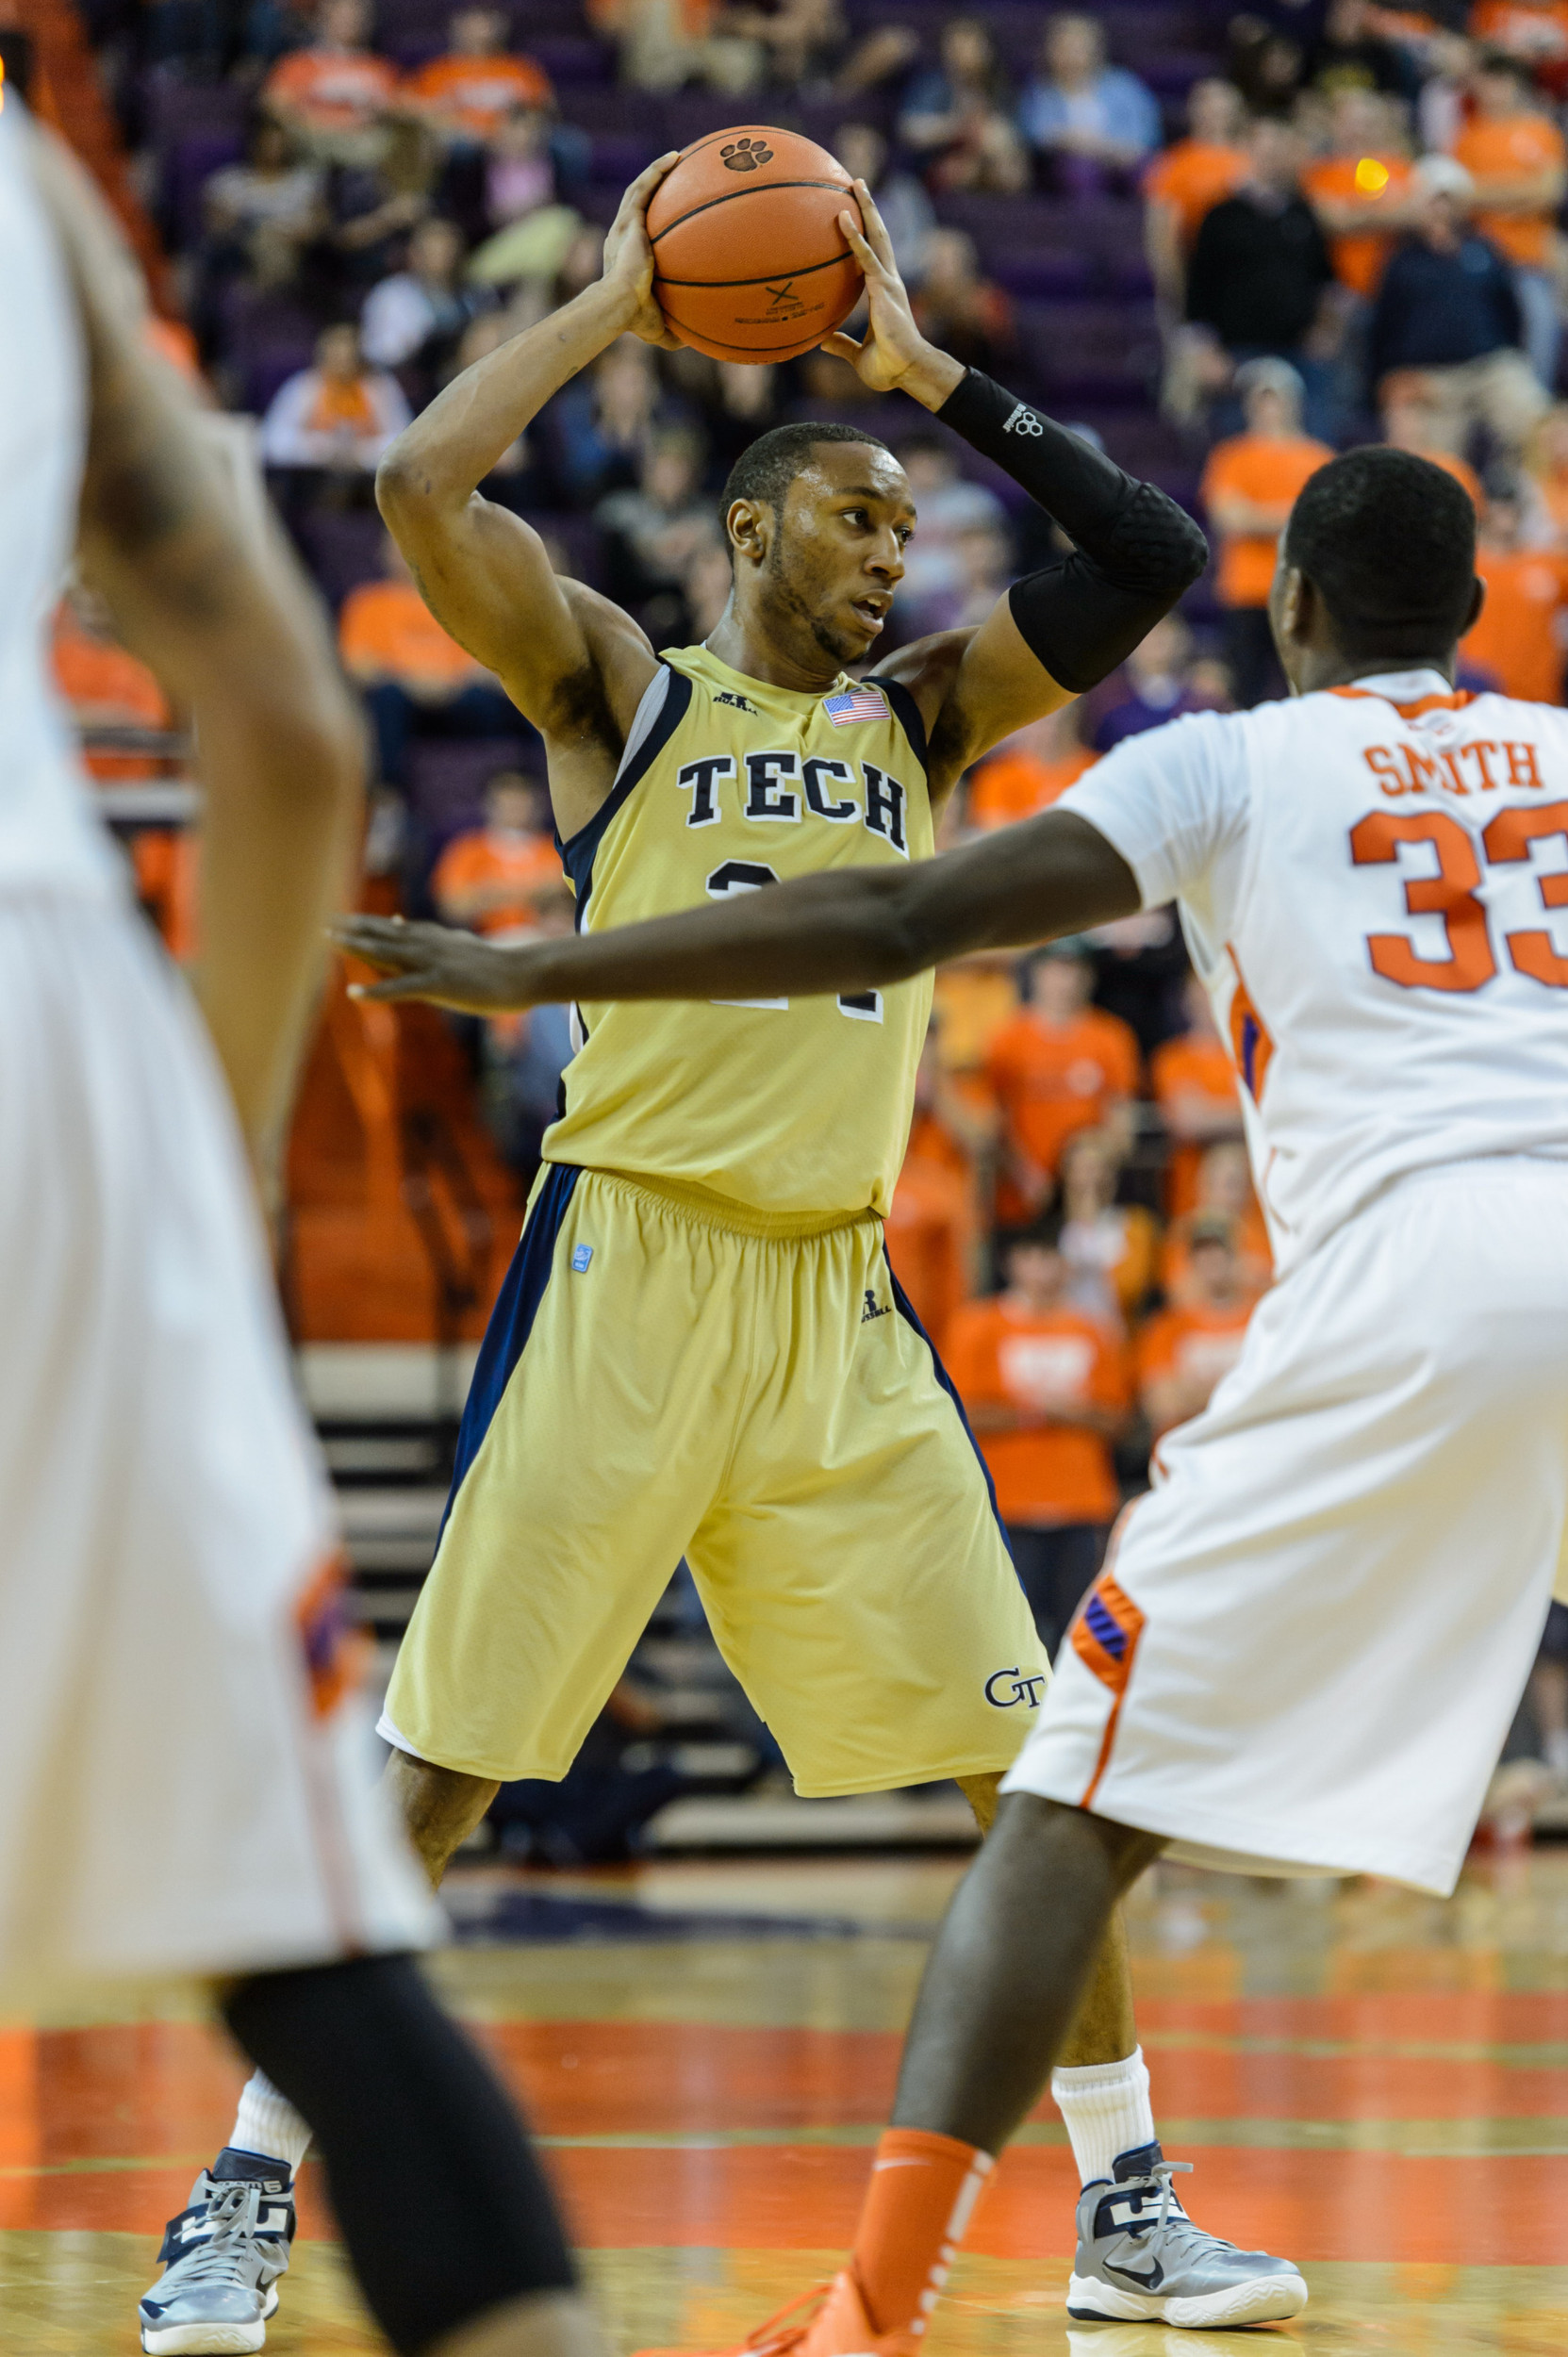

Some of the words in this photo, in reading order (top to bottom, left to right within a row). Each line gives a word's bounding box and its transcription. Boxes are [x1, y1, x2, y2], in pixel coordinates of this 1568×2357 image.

[1362, 740, 1545, 797] SMITH
[676, 750, 910, 862] TECH
[983, 1665, 1047, 1709] GT
